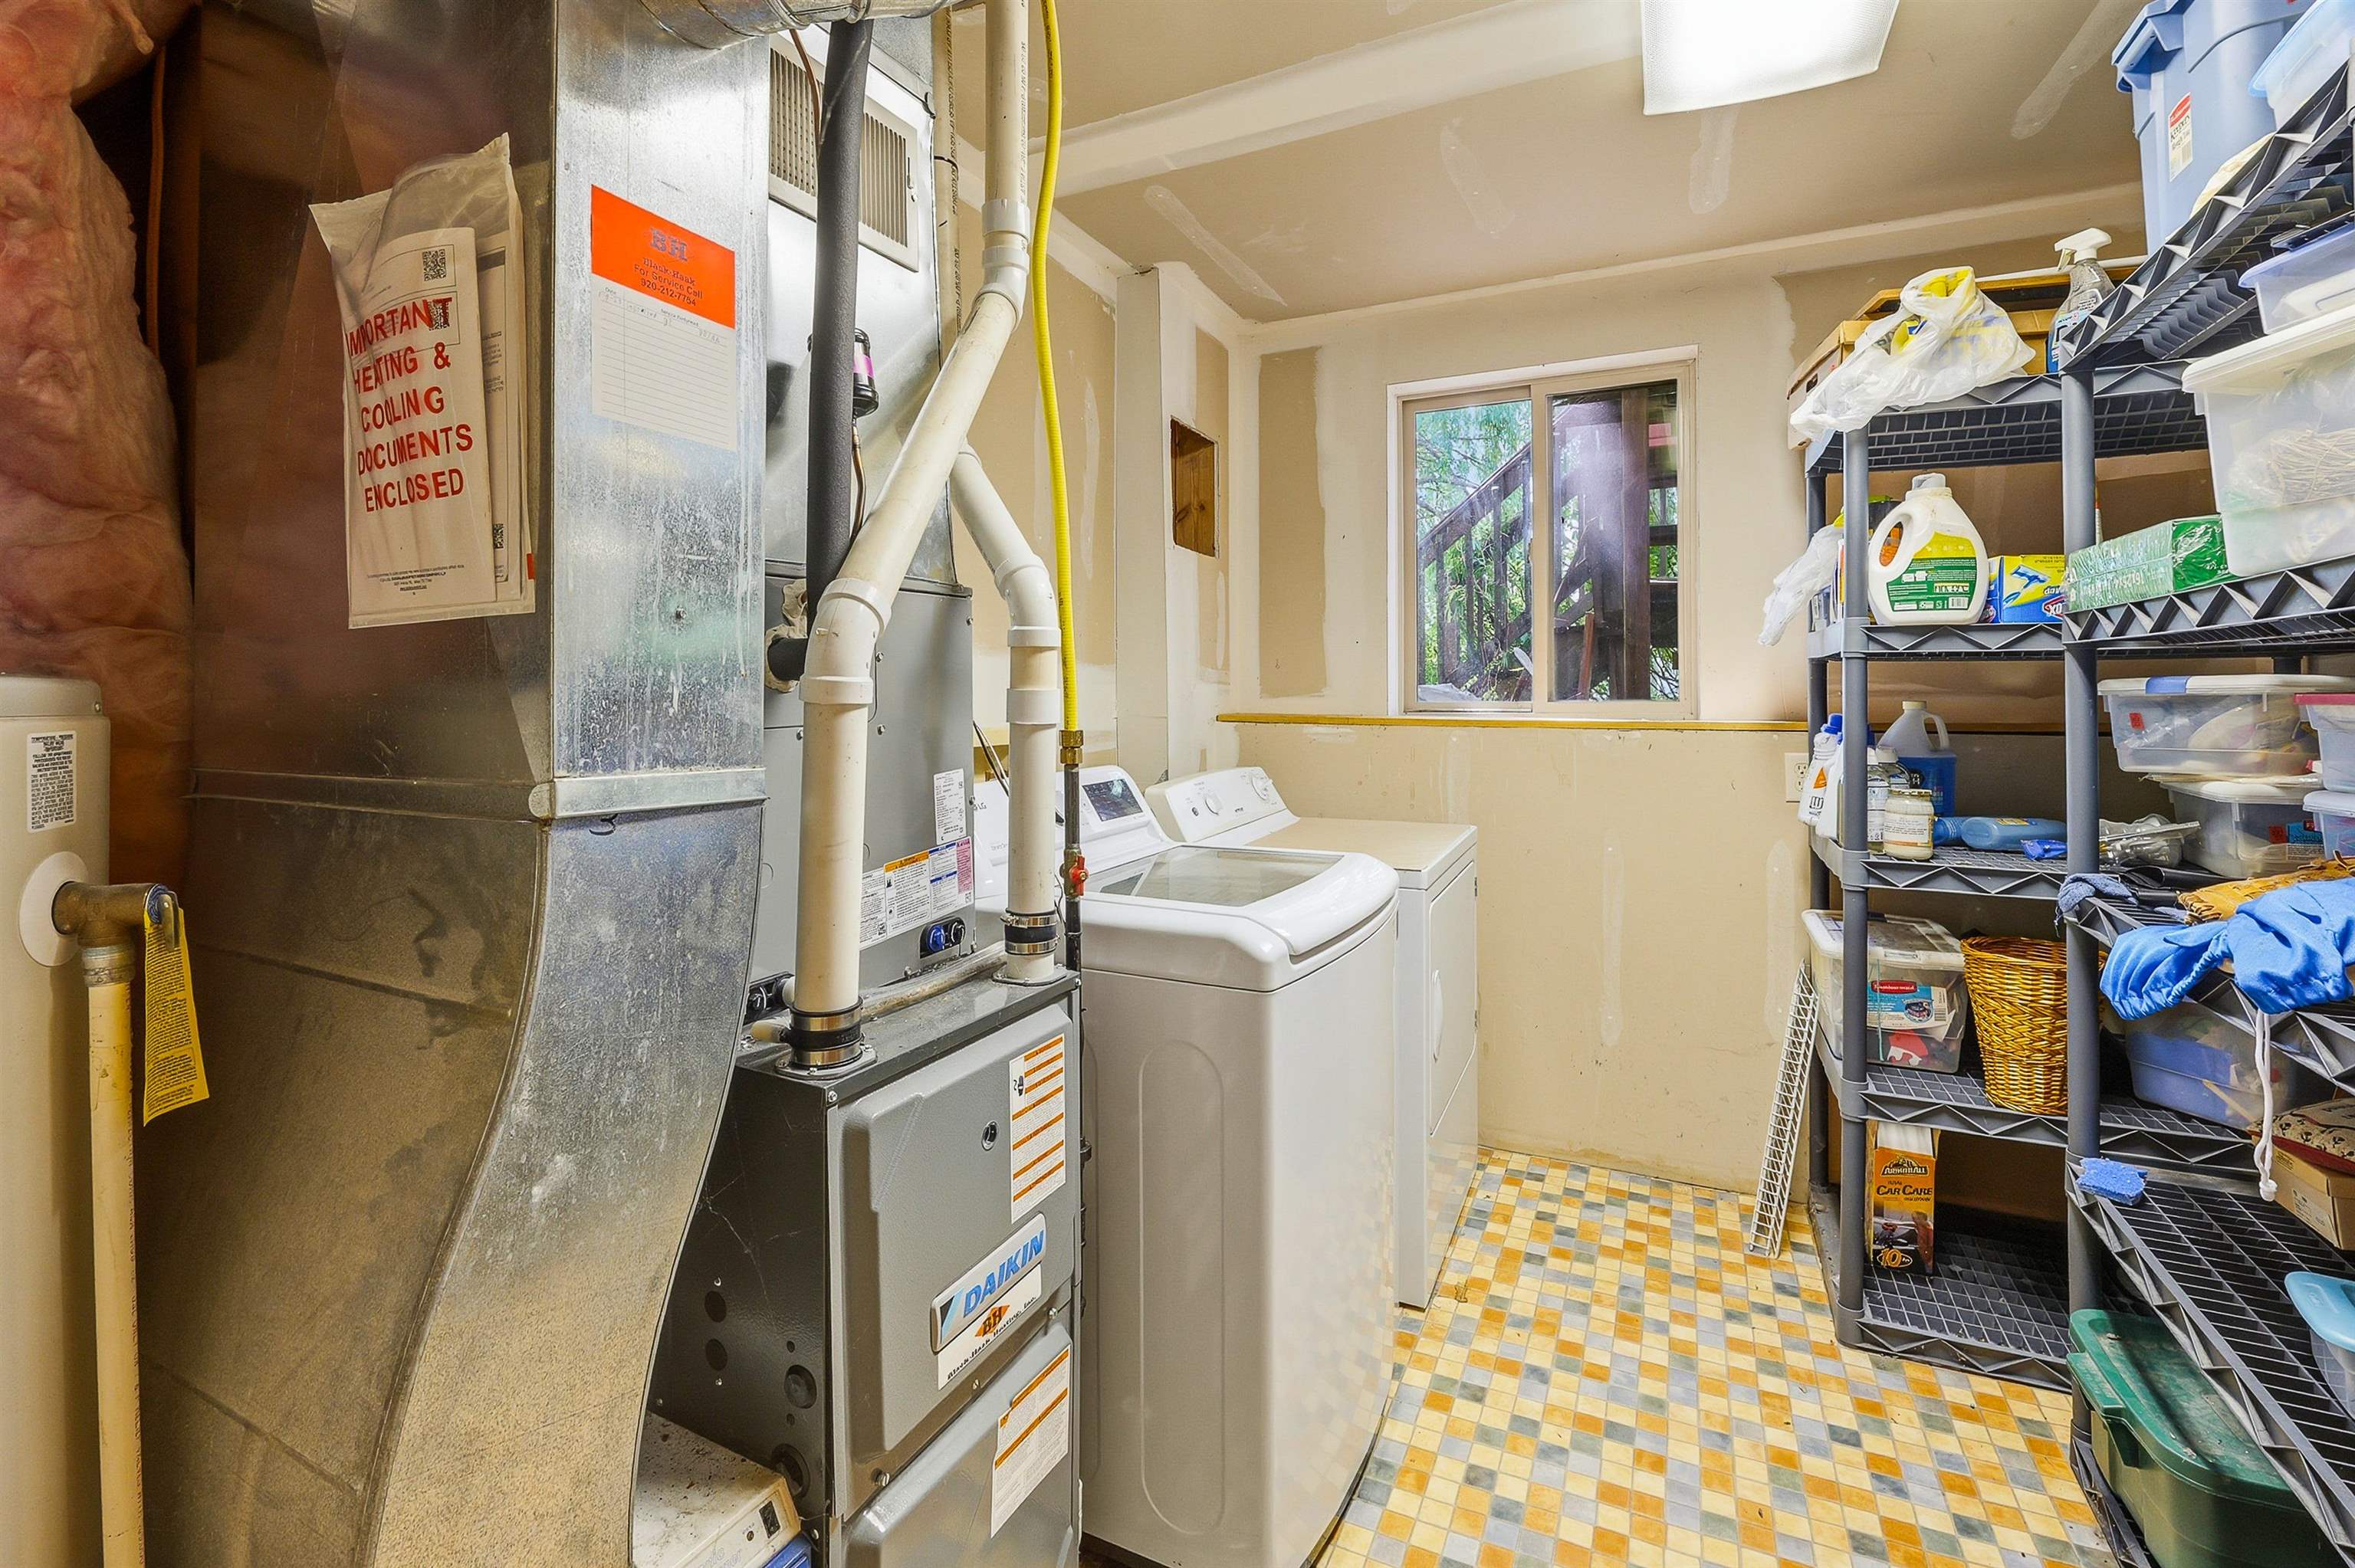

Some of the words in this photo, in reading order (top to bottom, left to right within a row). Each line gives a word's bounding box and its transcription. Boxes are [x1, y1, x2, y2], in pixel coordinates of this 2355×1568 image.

[651, 228, 688, 262] BH
[634, 264, 649, 277] For
[652, 271, 685, 293] Service
[686, 286, 703, 299] Call
[346, 297, 453, 357] IMPORTANT
[353, 346, 418, 395] HEATING
[434, 342, 451, 369] &
[361, 386, 445, 432] COOLING
[357, 424, 473, 476] DOCUMENTS
[364, 468, 464, 512] ENCLOSED
[964, 1230, 1044, 1318] DAIKIN
[1881, 1248, 1902, 1268] 10
[982, 1304, 1003, 1337] BH
